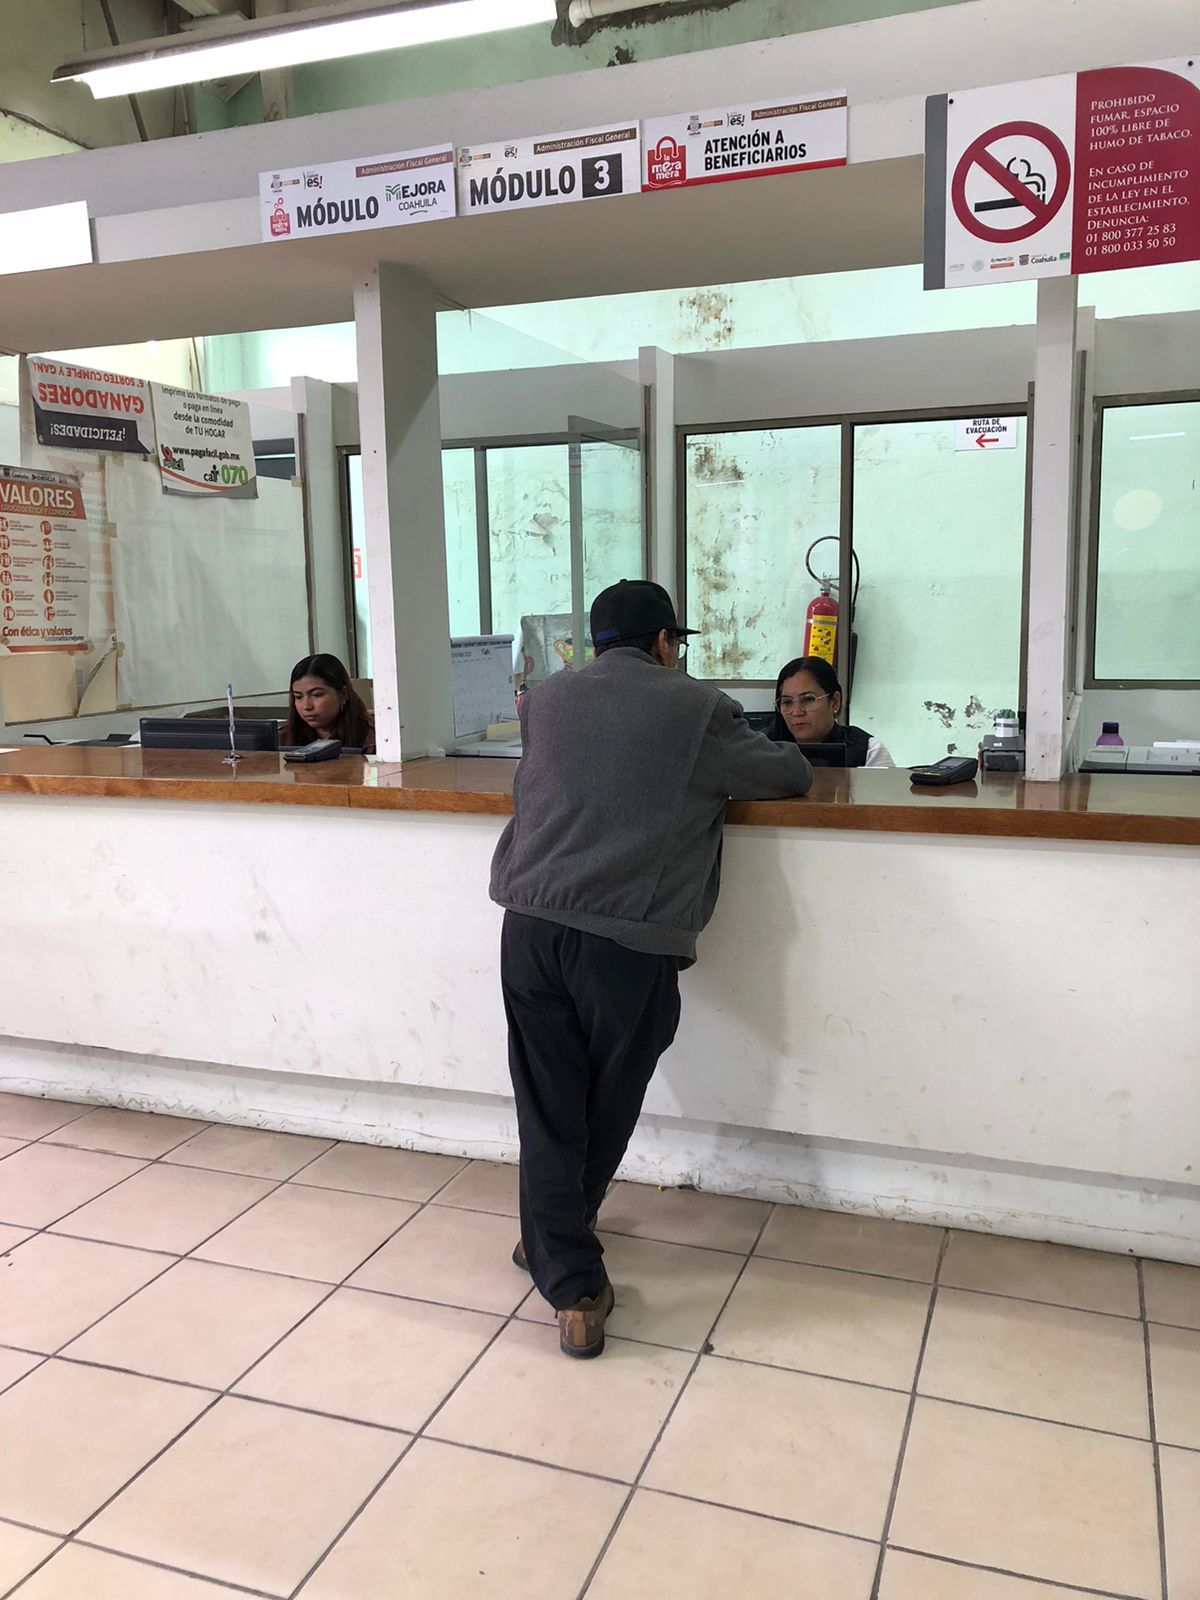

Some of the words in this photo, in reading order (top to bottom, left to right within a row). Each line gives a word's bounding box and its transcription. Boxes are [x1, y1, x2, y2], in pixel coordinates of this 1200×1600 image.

[799, 102, 817, 112] Fiscal
[817, 99, 841, 109] General
[1091, 93, 1156, 110] PROHIBIDO
[1134, 103, 1180, 118] ESPACIO
[1090, 125, 1119, 138] 100%
[1121, 121, 1151, 133] LIBRE
[1155, 118, 1170, 129] DE
[536, 137, 585, 153] Administración
[585, 135, 605, 146] Fiscal
[605, 131, 630, 143] General
[704, 129, 770, 154] ATENCIÓN
[775, 129, 784, 144] A
[1090, 138, 1125, 151] HUMO
[1129, 135, 1144, 146] DE
[1146, 129, 1193, 143] TABACO.
[424, 154, 447, 166] General
[704, 143, 807, 170] BENEFICIARIOS
[651, 161, 682, 174] mera
[655, 170, 680, 180] mera
[1089, 167, 1104, 178] EN
[1107, 162, 1136, 175] CASO
[1140, 160, 1155, 171] DE
[470, 165, 576, 206] MÓDULO
[593, 160, 610, 190] 3
[1088, 169, 1189, 190] INCUMPLIMIENTO
[1088, 194, 1102, 204] DE
[1106, 191, 1119, 201] LA
[1122, 188, 1141, 200] LEY
[1144, 186, 1159, 197] EN
[1162, 184, 1174, 194] EL
[296, 196, 379, 228] MÓDULO
[398, 198, 437, 212] COAHUILA
[1087, 215, 1150, 230] DENUNCIA:
[1086, 232, 1098, 244] 01
[1102, 229, 1122, 242] 800
[1124, 226, 1144, 239] 377
[1147, 224, 1160, 236] 25
[1163, 222, 1177, 234] 83
[1085, 246, 1098, 257] 01
[1101, 243, 1121, 255] 800
[1123, 240, 1143, 252] 033
[1146, 238, 1160, 250] 50
[1162, 236, 1176, 247] 50
[60, 366, 65, 377] Y
[66, 367, 102, 381] CUMPLE
[104, 373, 136, 387] SORTEO
[37, 382, 144, 414] GANADORES
[188, 403, 202, 413] paga
[173, 411, 192, 423] desde
[193, 414, 200, 423] la
[201, 416, 234, 428] comodidad
[973, 418, 990, 426] RUTA
[50, 423, 126, 441] ¡FELICIDADES!
[185, 425, 193, 435] de
[194, 426, 203, 437] TU
[205, 428, 226, 438] HOGAR
[966, 425, 1008, 434] EVACUACIÓN
[172, 446, 240, 461] www.pagafacil.gob.mx
[221, 464, 249, 485] 070
[0, 482, 75, 509] VALORES
[2, 626, 19, 637] Con
[20, 625, 40, 637] ética
[45, 626, 73, 636] valores
